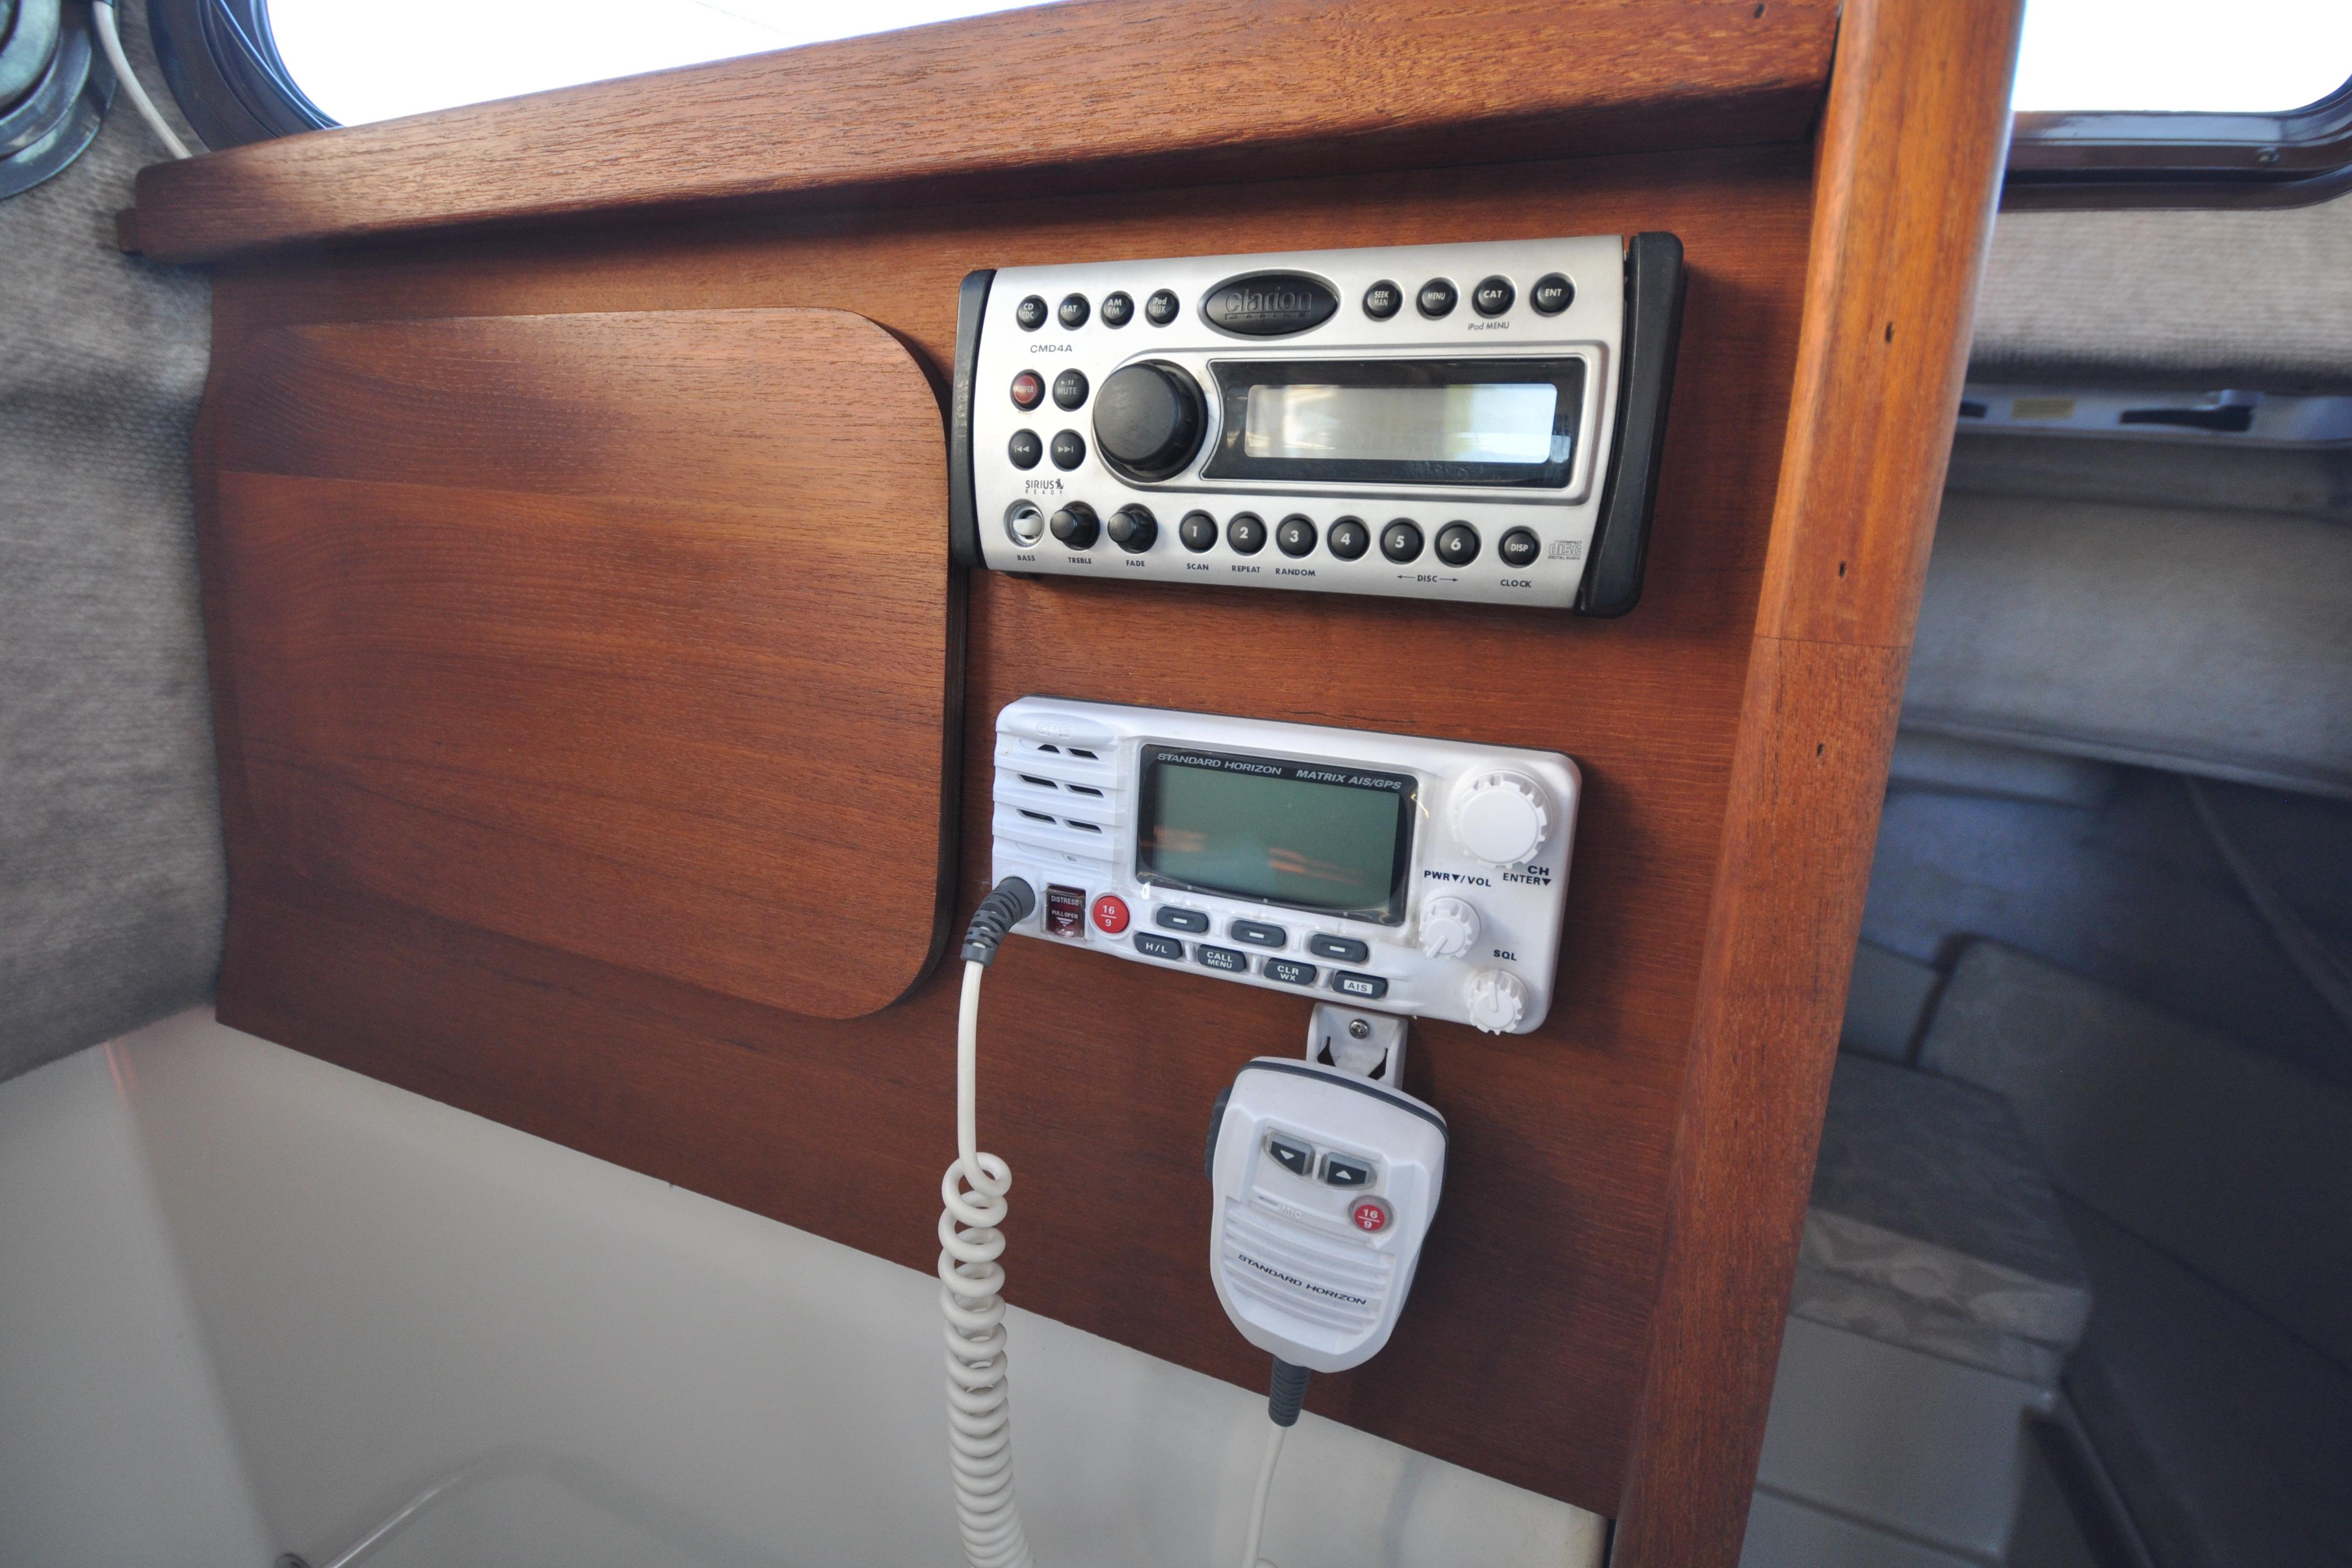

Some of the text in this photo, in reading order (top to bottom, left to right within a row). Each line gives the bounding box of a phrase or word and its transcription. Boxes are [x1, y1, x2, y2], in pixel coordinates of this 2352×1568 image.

[1428, 292, 1445, 300] MENU
[1484, 290, 1502, 298] CAT
[1545, 288, 1562, 297] ENT
[1152, 297, 1167, 306] iPod
[1225, 286, 1312, 313] clarion
[1108, 307, 1119, 315] FM
[1152, 306, 1166, 314] AUX
[1022, 311, 1035, 319] CDC
[1468, 322, 1510, 330] iPod MENU
[1030, 344, 1073, 353] CMD4A
[1014, 385, 1034, 394] POWER
[1057, 386, 1077, 395] MUTE
[1025, 480, 1054, 489] SIRIUS
[1193, 526, 1197, 537] 1
[1239, 526, 1249, 539] 2
[1289, 530, 1299, 542] 3
[1341, 533, 1351, 545] 4
[1395, 536, 1404, 548] 5
[1451, 538, 1461, 551] 6
[1511, 543, 1529, 552] DISP
[1186, 563, 1209, 571] SCAN
[1232, 565, 1261, 573] REPEAT
[1275, 568, 1316, 577] RANDOM
[1417, 574, 1438, 582] DISC
[1500, 579, 1532, 588] CLOCK
[1036, 721, 1073, 739] GPS
[1157, 753, 1402, 790] STANDARD HORIZON MATRIX AIS/GPS
[1527, 865, 1549, 876] CH
[1502, 872, 1540, 885] ENTER
[1051, 895, 1080, 906] DISTRESS
[1052, 910, 1065, 918] PULL
[1102, 905, 1115, 914] 16
[1105, 918, 1112, 927] 9
[1206, 951, 1233, 963] CALL
[1493, 949, 1517, 961] SQL
[1207, 959, 1233, 970] MENU
[1277, 965, 1299, 976] CLR
[1280, 973, 1297, 982] WX
[1347, 982, 1368, 992] AIS
[1281, 1205, 1302, 1219] MIC
[1363, 1208, 1378, 1219] 16
[1364, 1221, 1372, 1229] 9
[1238, 1254, 1366, 1305] STANDARD HORIZON
